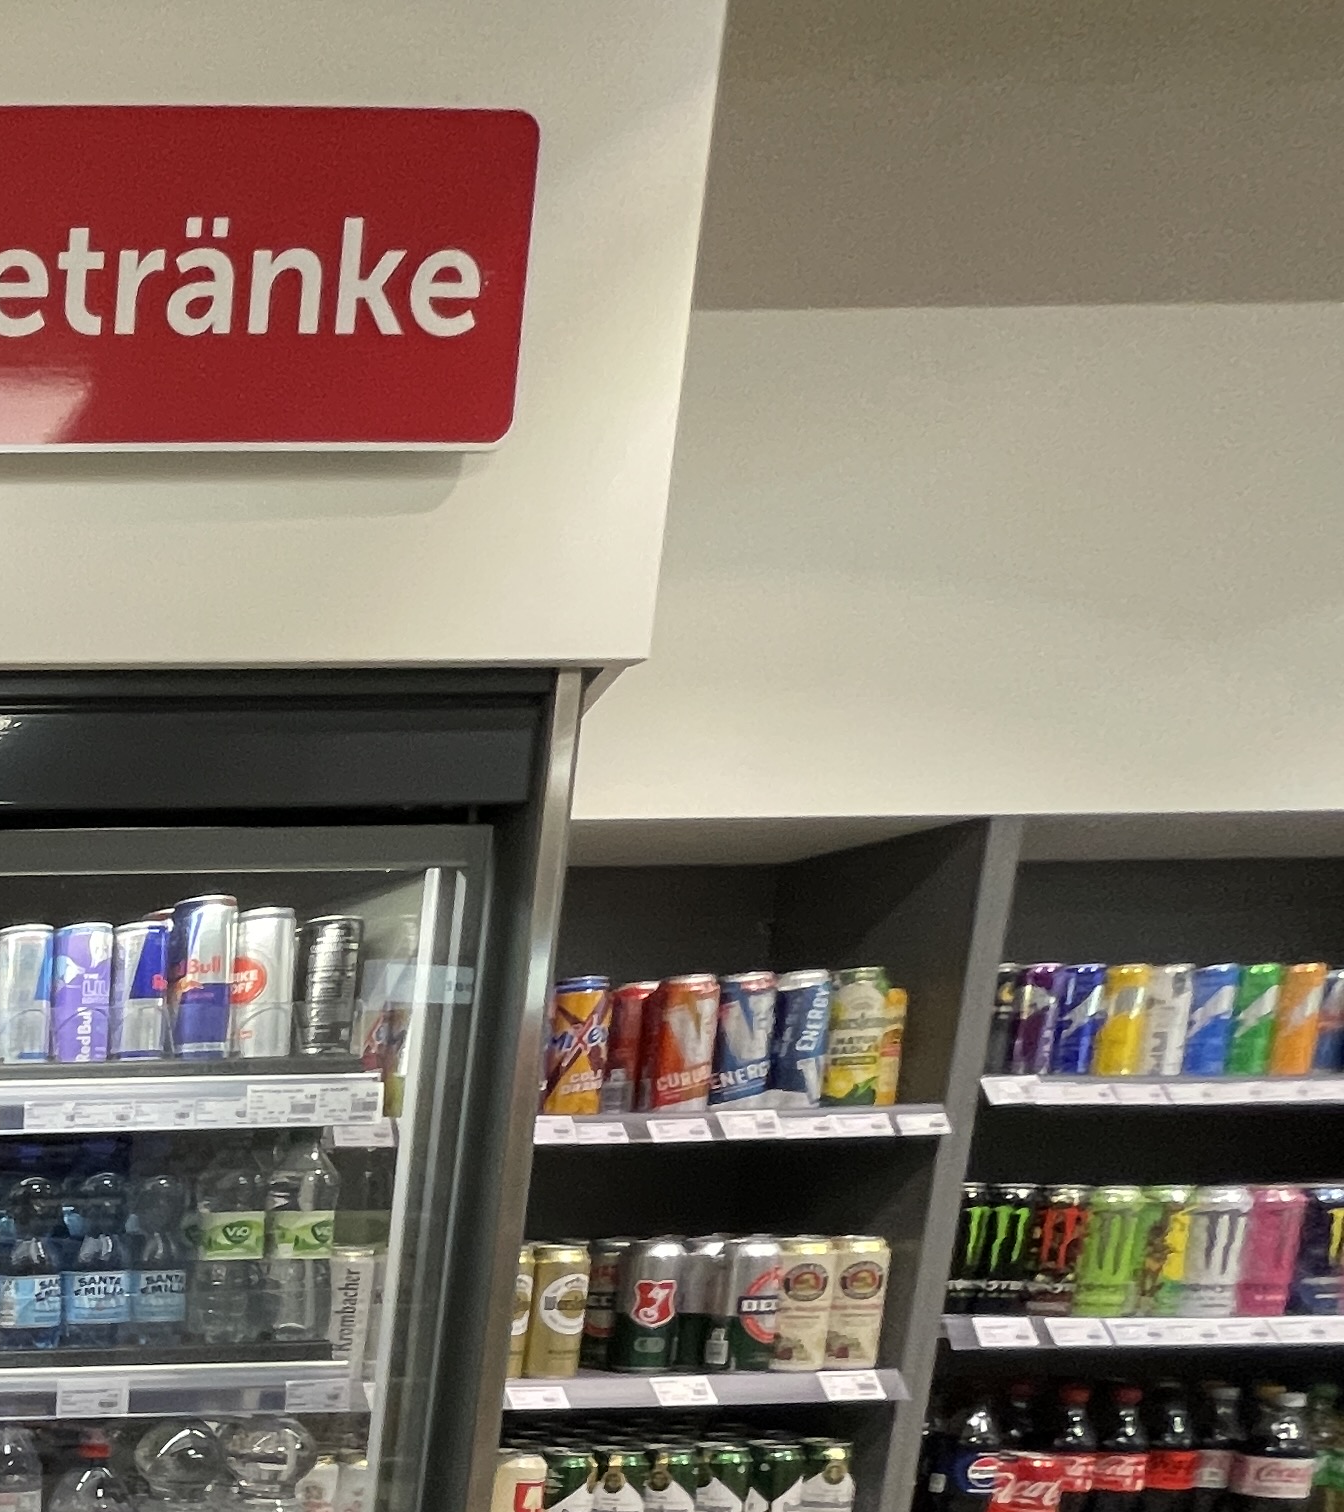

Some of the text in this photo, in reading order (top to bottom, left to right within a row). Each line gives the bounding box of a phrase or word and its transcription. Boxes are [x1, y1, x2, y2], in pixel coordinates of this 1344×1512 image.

[189, 957, 221, 975] Bull
[76, 1006, 92, 1062] Red Bull
[333, 1268, 361, 1352] Krombacher
